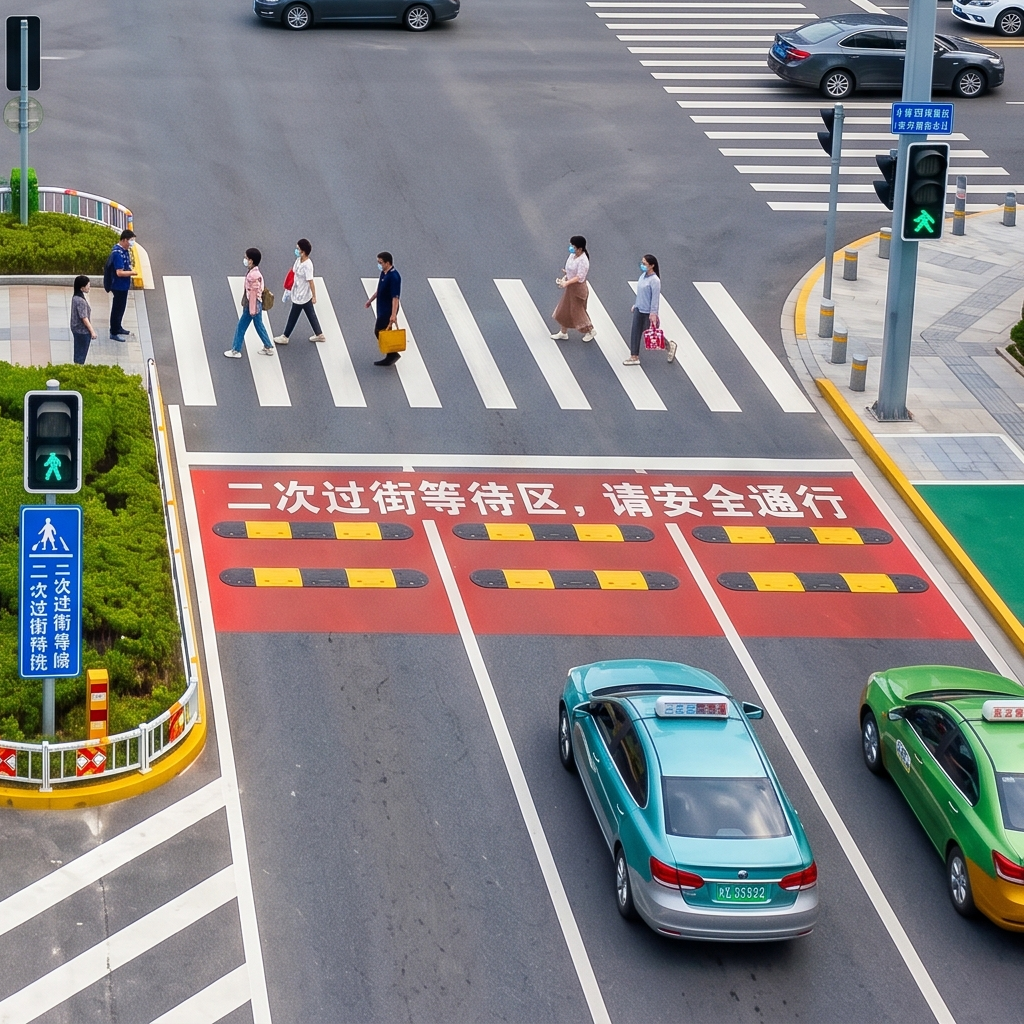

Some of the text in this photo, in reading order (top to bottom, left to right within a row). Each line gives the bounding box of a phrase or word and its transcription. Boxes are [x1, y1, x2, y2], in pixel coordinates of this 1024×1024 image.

[227, 479, 848, 520] 二次过街等待区，请安全通行
